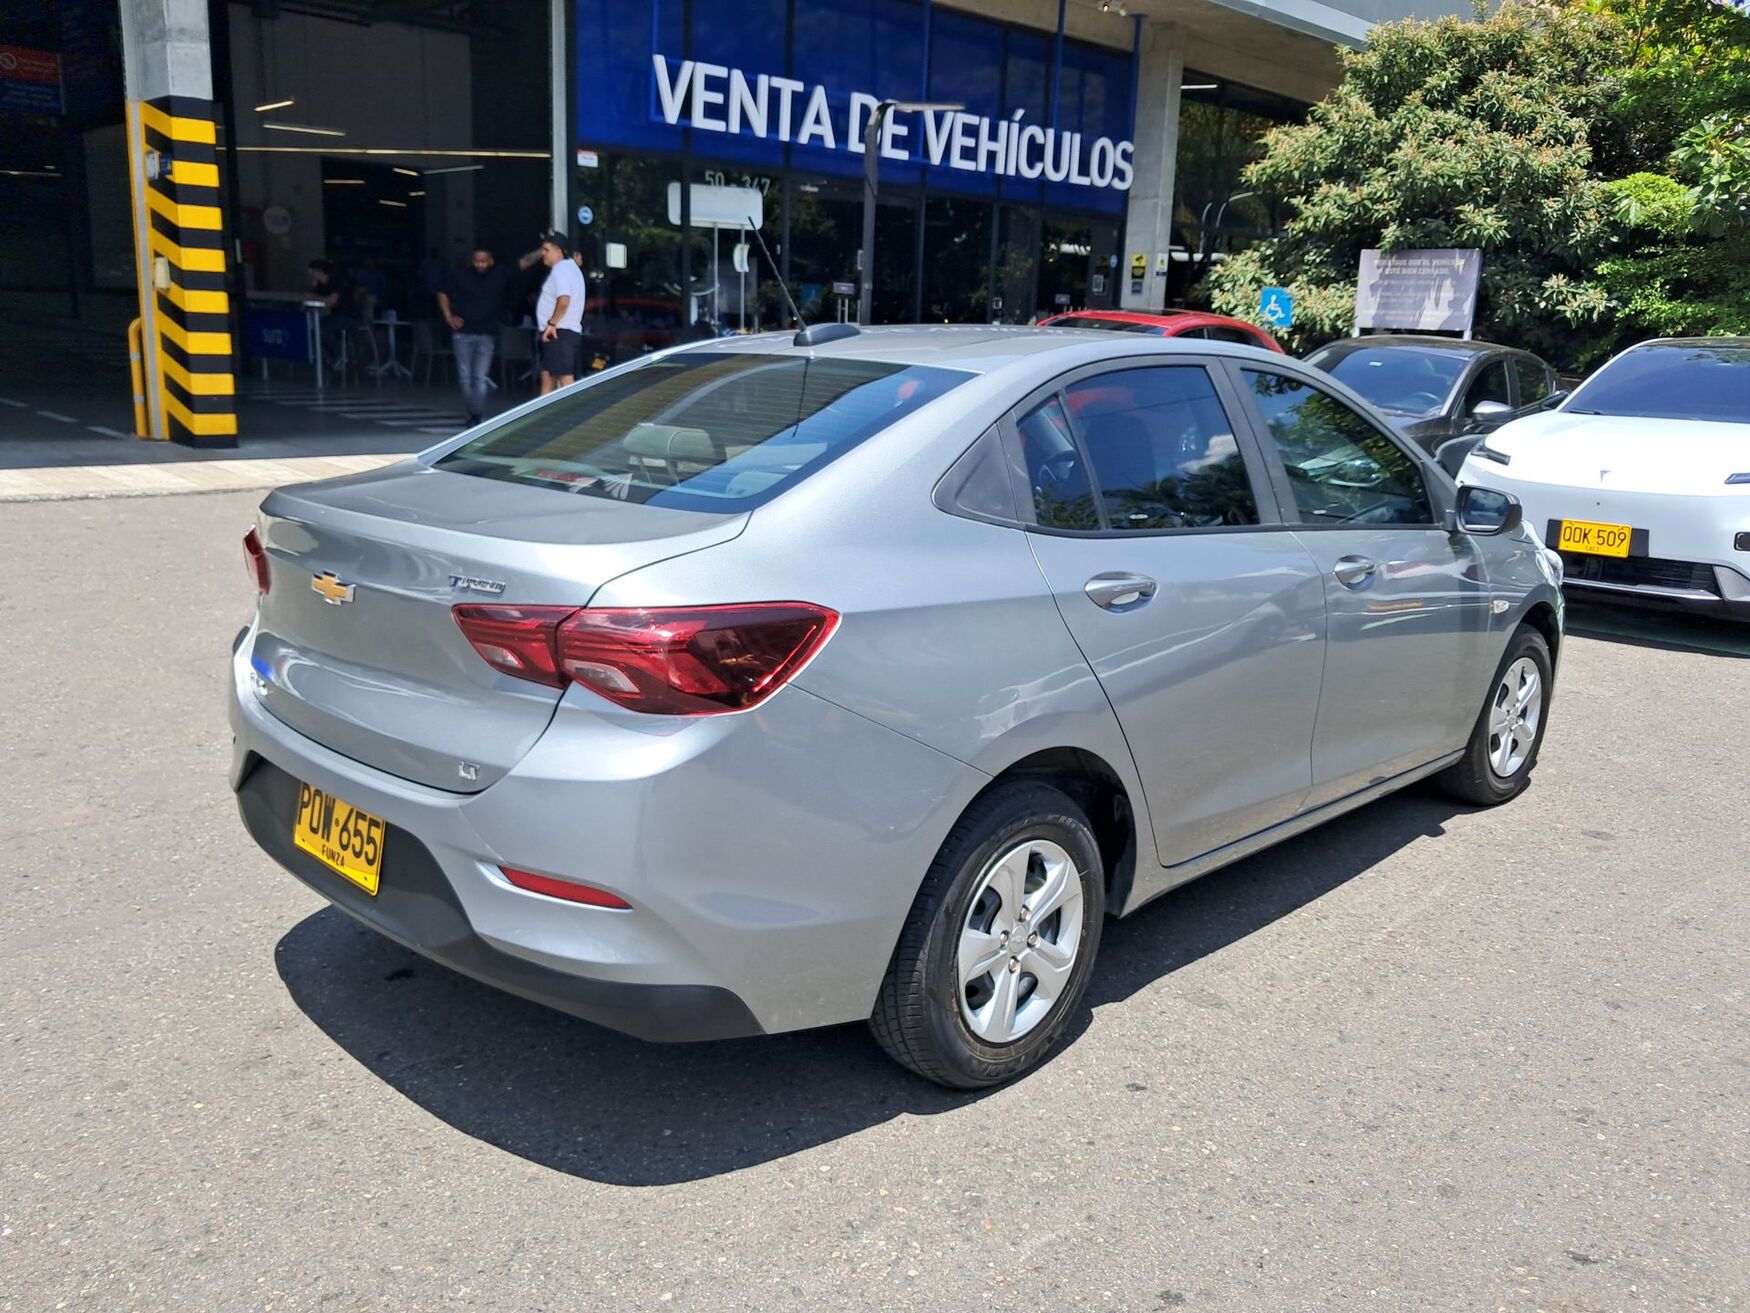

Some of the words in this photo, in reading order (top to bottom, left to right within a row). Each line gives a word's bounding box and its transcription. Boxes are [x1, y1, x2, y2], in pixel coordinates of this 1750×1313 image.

[652, 53, 836, 149] VENTA
[848, 91, 909, 160] DE
[924, 108, 1135, 191] VEHÍCULOS
[1596, 529, 1627, 548] 509
[298, 782, 336, 842] POW
[339, 807, 381, 867] 655
[321, 844, 346, 868] FUNZA
